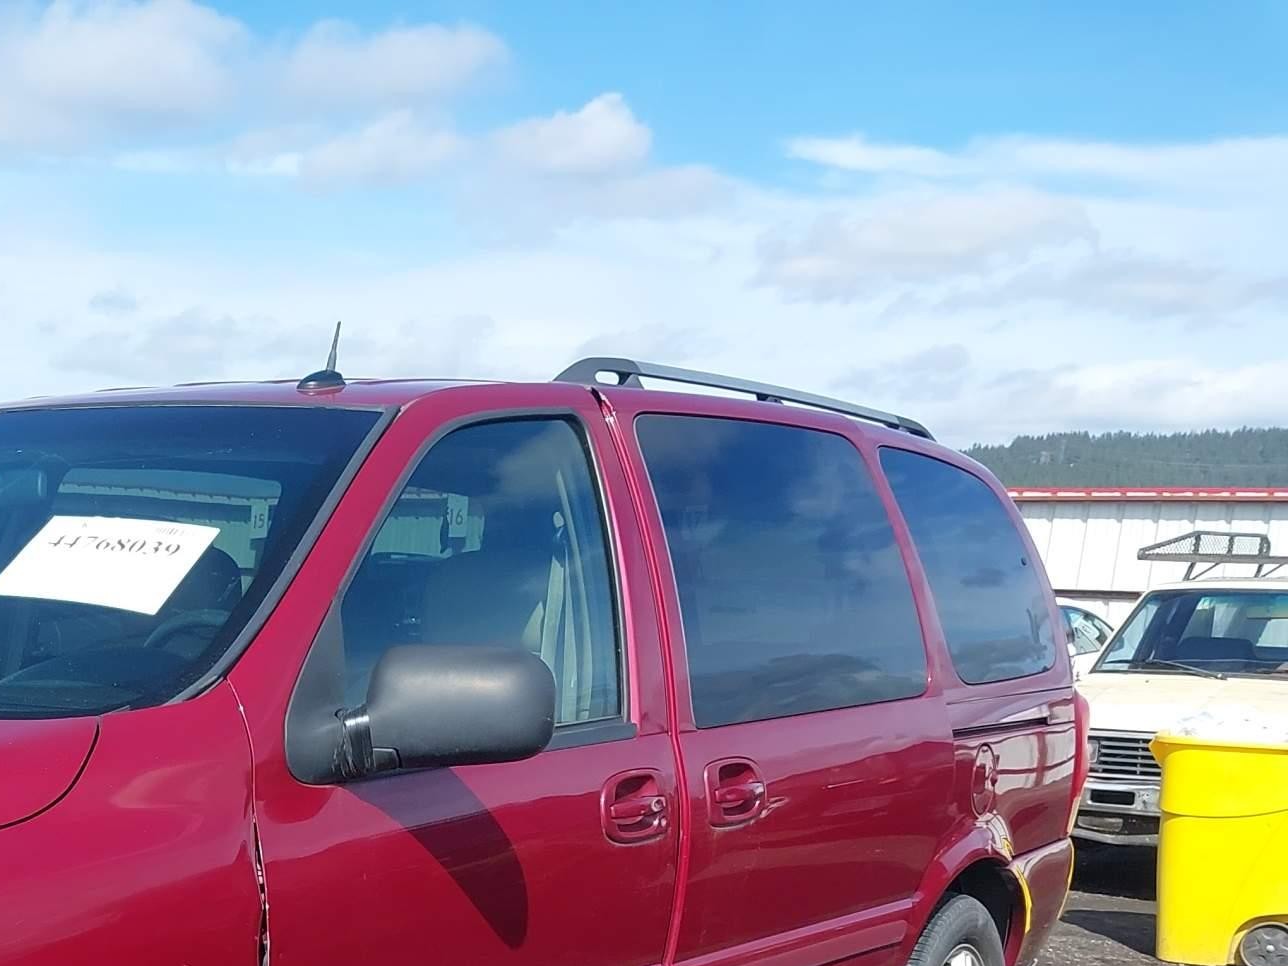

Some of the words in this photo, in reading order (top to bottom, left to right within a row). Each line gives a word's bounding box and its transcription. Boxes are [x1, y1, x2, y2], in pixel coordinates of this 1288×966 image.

[253, 512, 265, 529] 15
[450, 508, 464, 526] 16
[48, 535, 182, 556] 44768039
